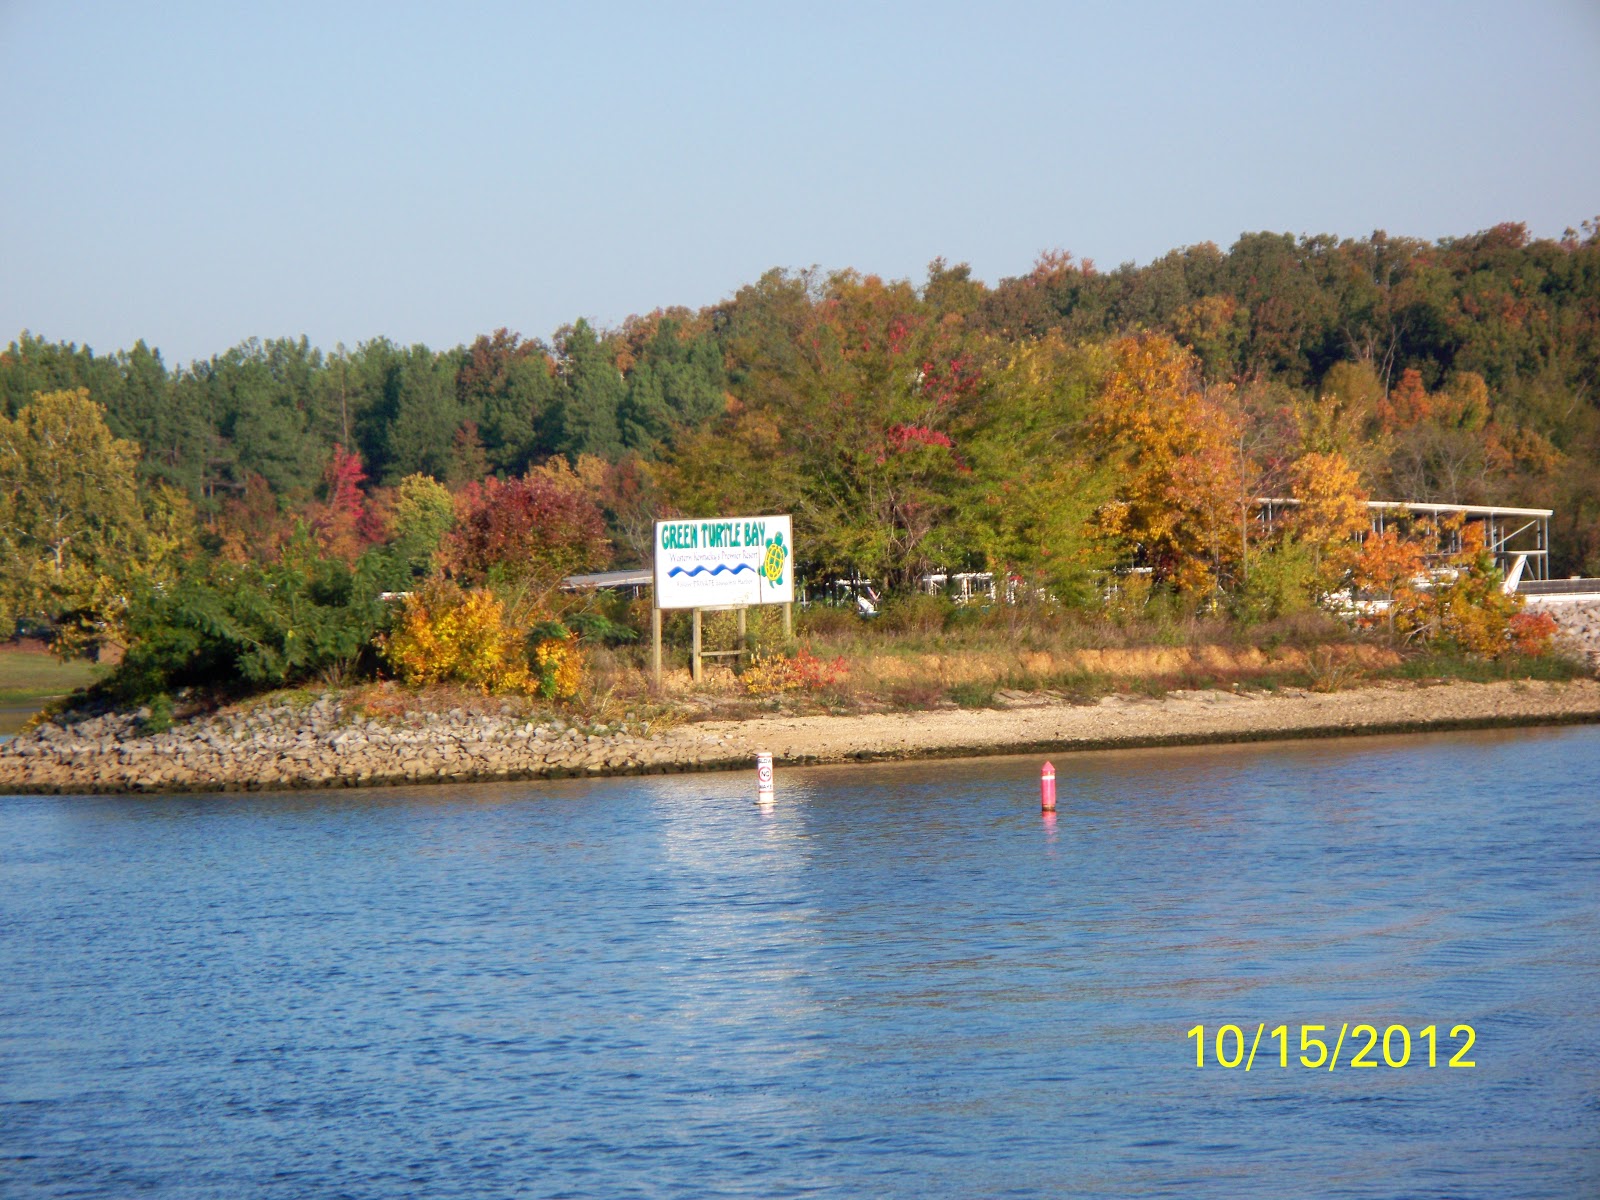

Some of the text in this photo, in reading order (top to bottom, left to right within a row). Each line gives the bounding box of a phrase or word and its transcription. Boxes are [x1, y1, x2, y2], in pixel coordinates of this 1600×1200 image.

[661, 521, 766, 550] GREEN TURTLE BAY
